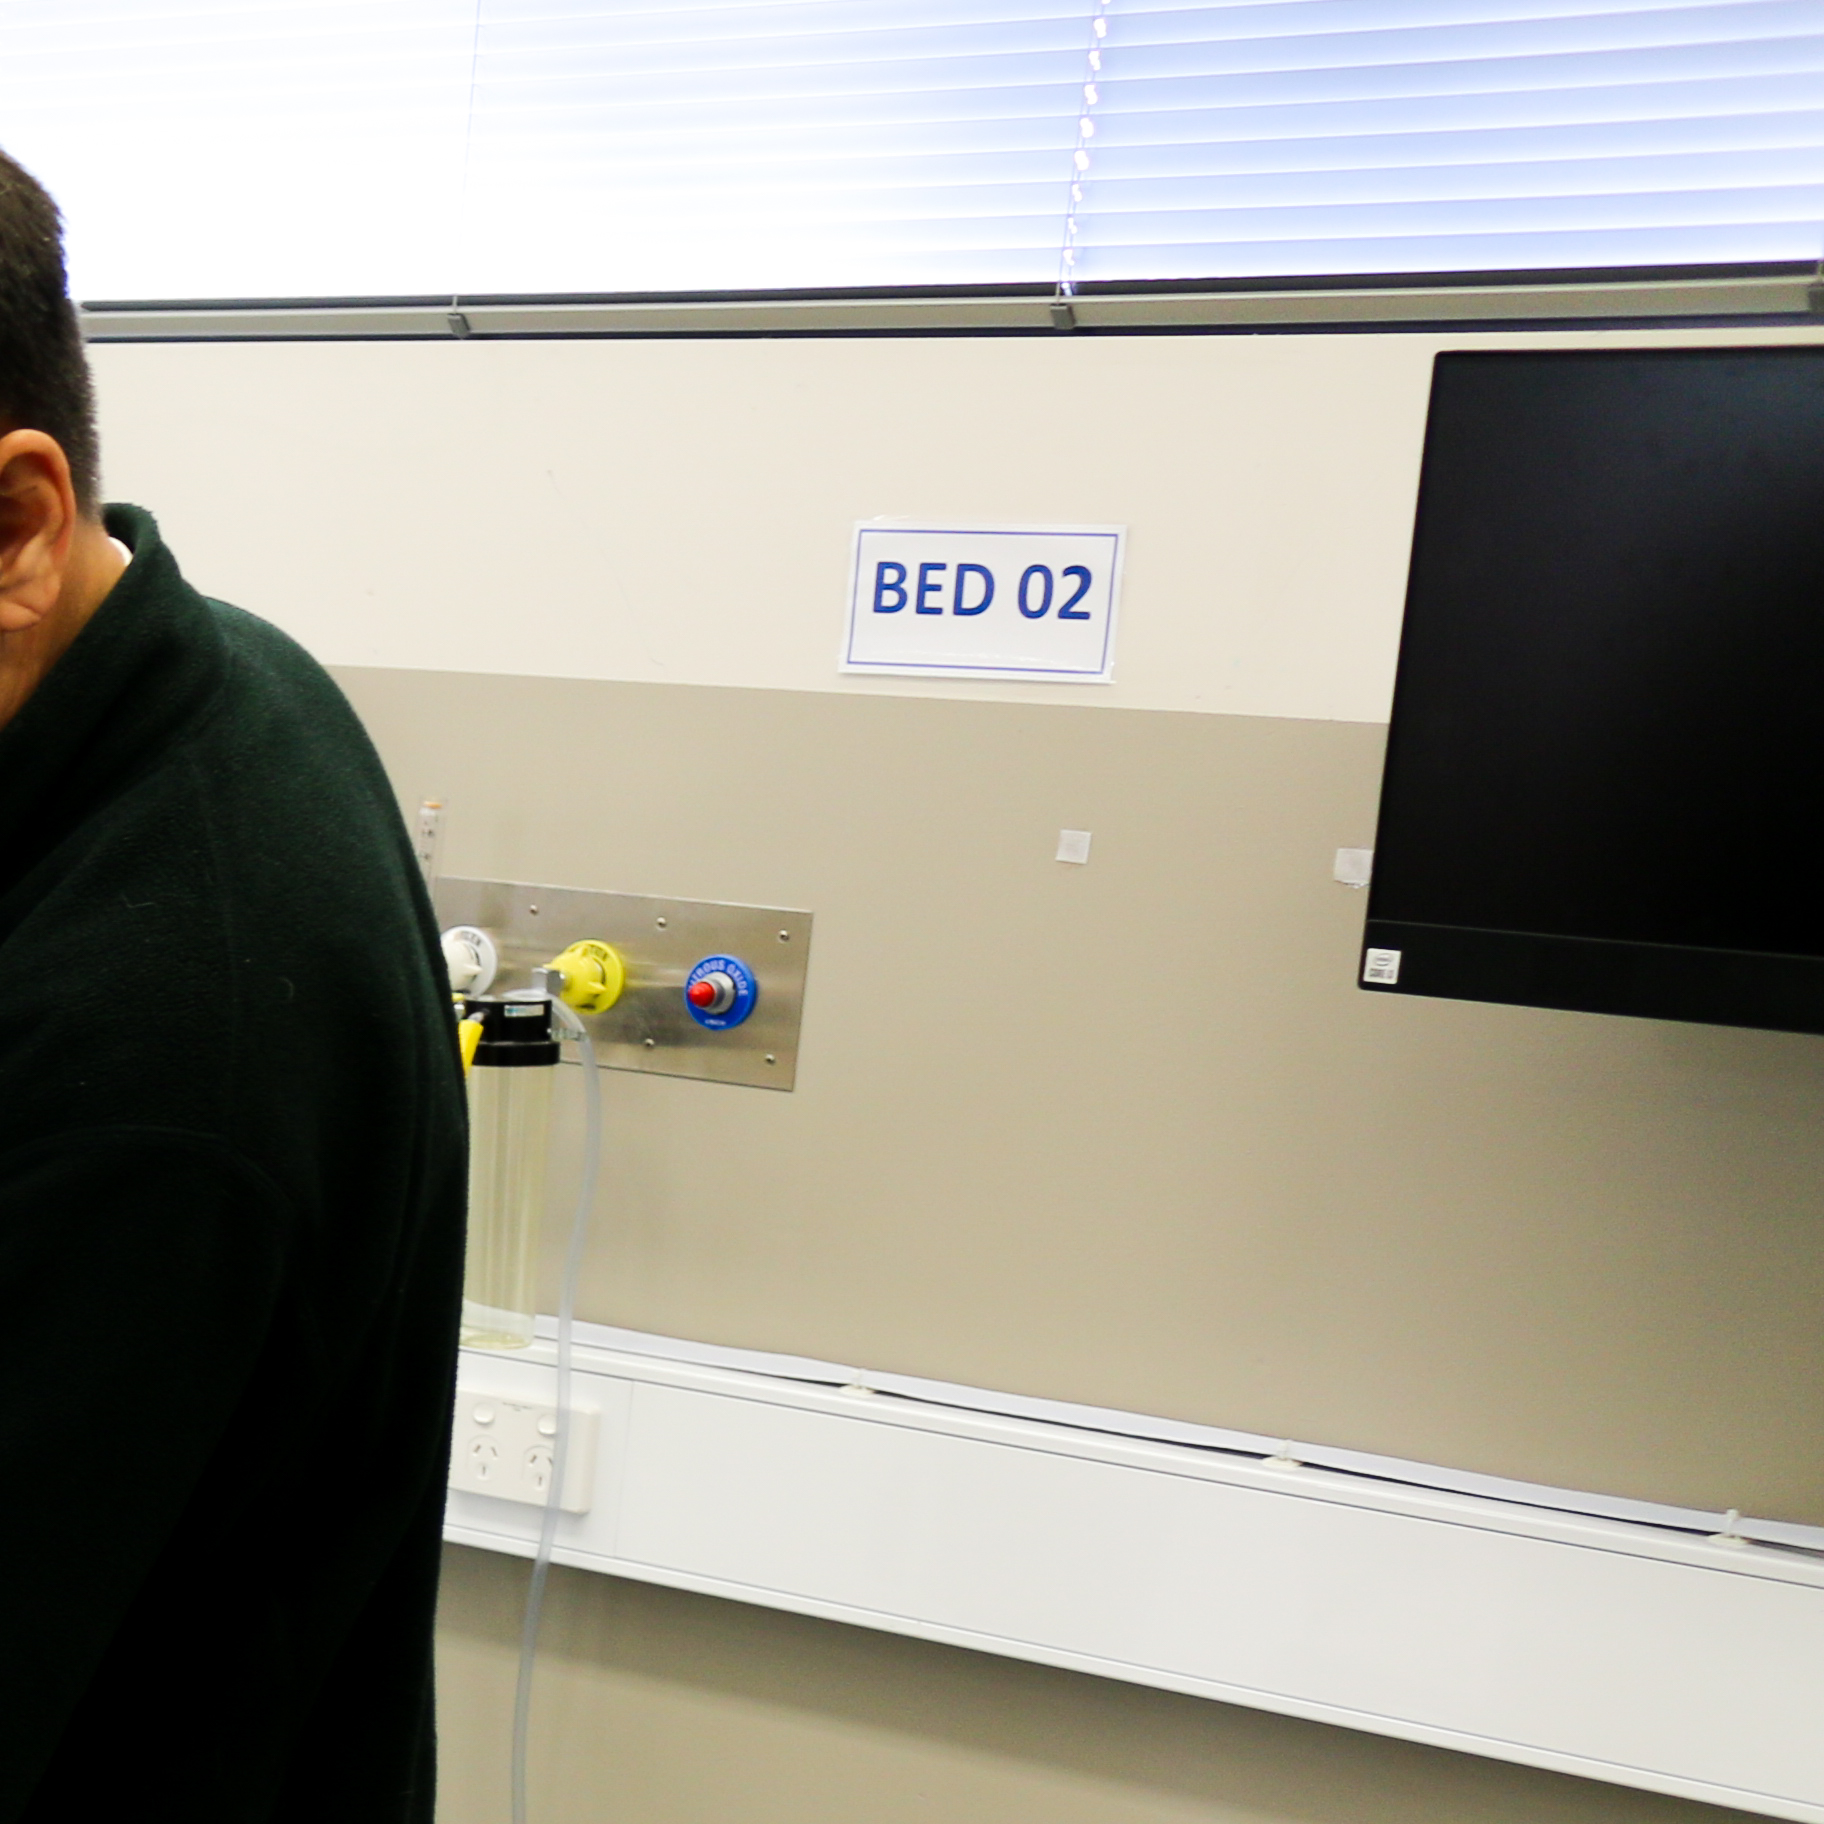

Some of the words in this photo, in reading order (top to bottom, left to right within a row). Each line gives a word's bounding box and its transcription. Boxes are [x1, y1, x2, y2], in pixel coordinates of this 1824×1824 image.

[873, 561, 995, 616] BED
[1017, 564, 1092, 620] 02
[726, 962, 749, 997] OXIDE
